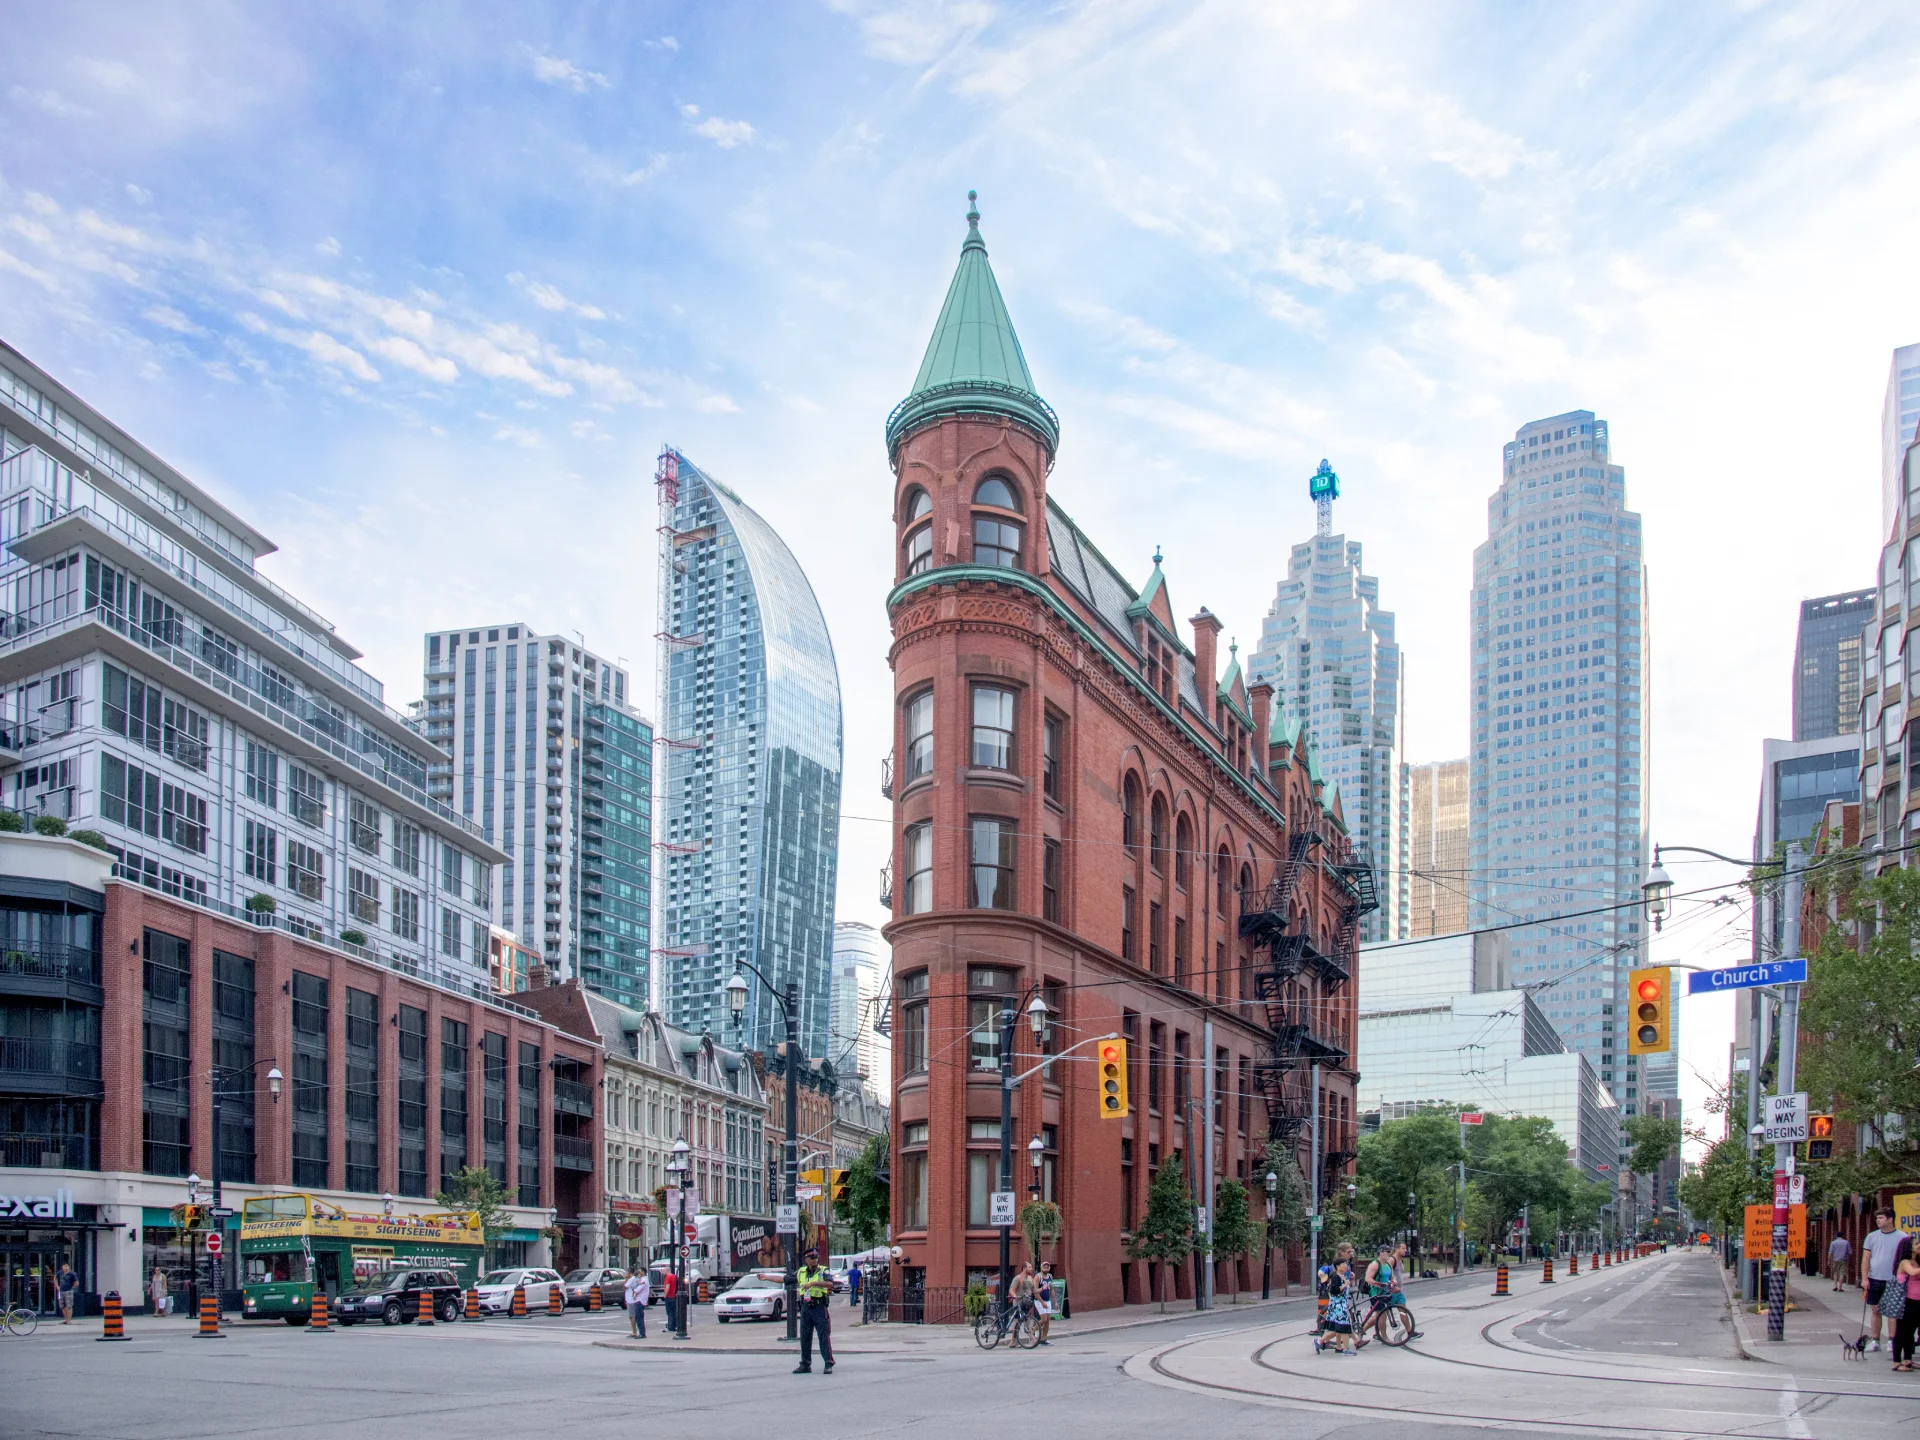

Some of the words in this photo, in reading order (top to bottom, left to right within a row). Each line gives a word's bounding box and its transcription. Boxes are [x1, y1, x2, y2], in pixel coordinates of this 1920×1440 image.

[1315, 477, 1328, 487] TD
[1711, 966, 1768, 986] Church
[1773, 964, 1782, 972] St
[1775, 1098, 1796, 1109] ONE
[1775, 1112, 1795, 1124] WAY
[1767, 1126, 1805, 1139] BEGINS
[996, 1195, 1009, 1203] ONE
[784, 1208, 792, 1216] NO
[996, 1205, 1009, 1213] WAY
[992, 1215, 1014, 1223] BEGINS
[243, 1220, 302, 1231] SIGHTSEEING
[376, 1226, 441, 1238] SIGHTSEEING
[732, 1225, 765, 1243] Canadian
[737, 1239, 762, 1257] Grown
